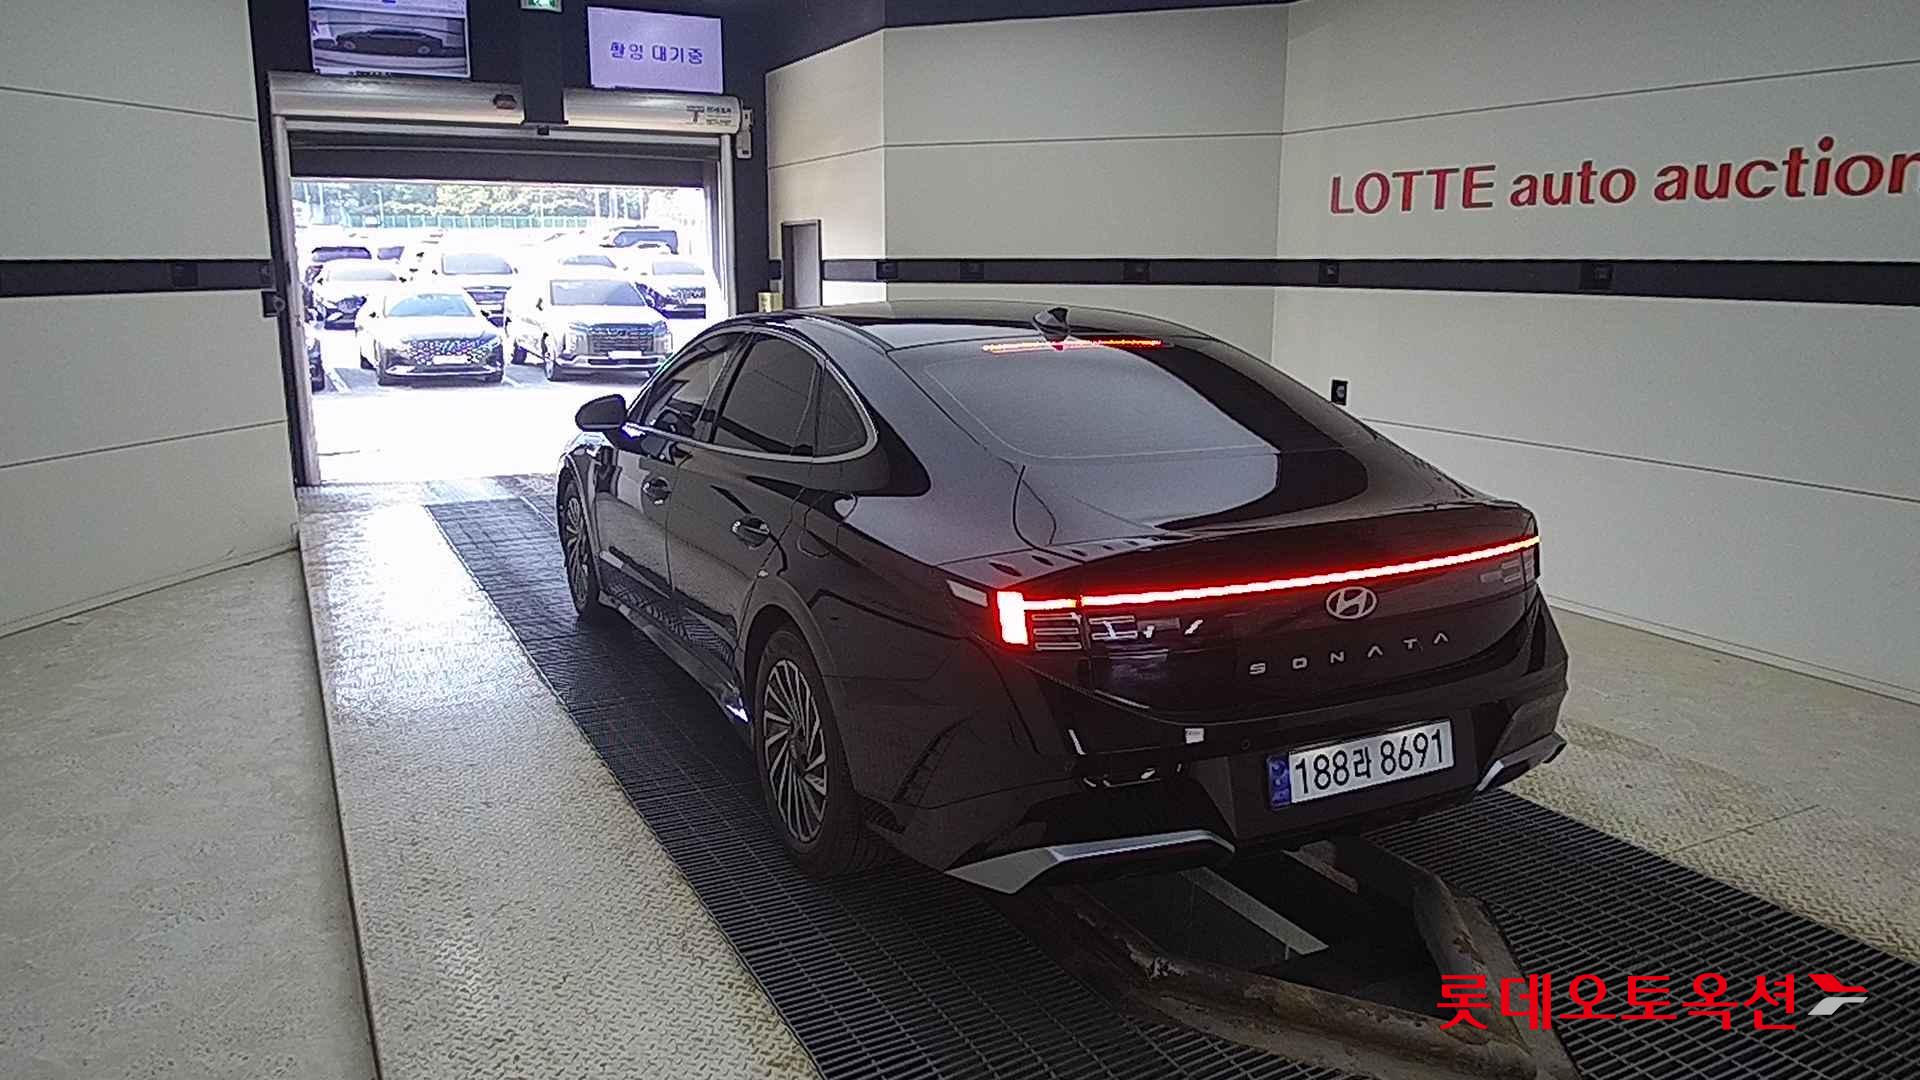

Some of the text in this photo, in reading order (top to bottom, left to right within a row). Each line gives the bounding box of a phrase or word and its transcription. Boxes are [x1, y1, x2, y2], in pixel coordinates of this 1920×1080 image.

[651, 44, 703, 65] 대기중
[1331, 164, 1497, 215] LOTTE
[1510, 159, 1637, 207] auto
[1249, 632, 1449, 676] SONATA
[1295, 728, 1443, 794] 188라 8691
